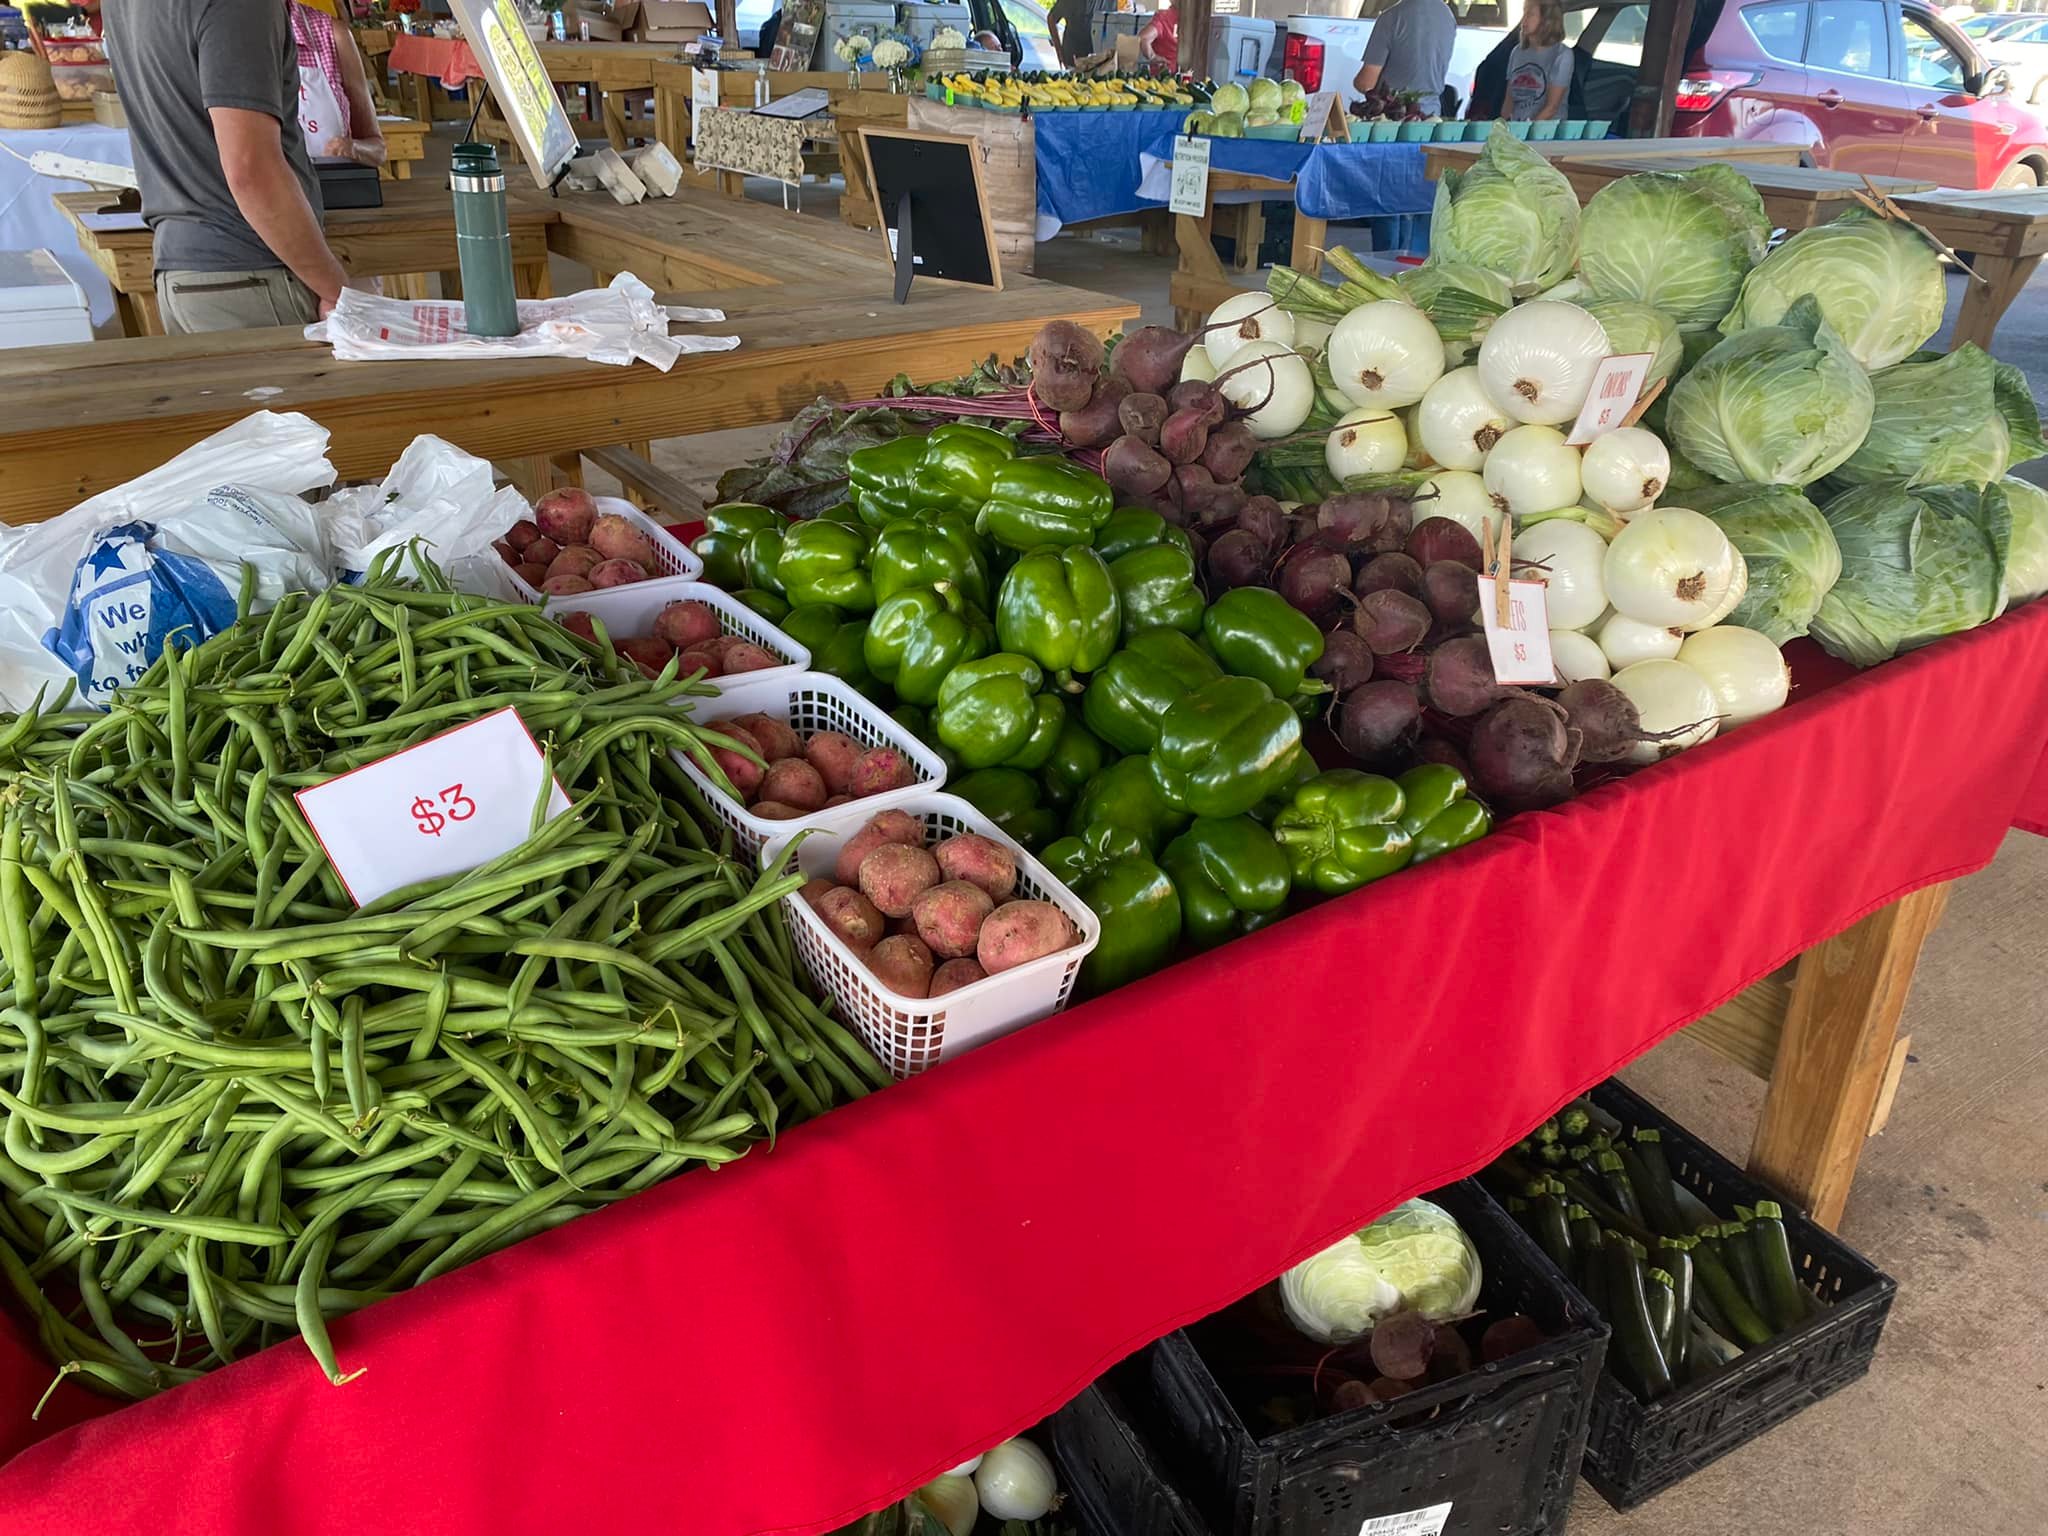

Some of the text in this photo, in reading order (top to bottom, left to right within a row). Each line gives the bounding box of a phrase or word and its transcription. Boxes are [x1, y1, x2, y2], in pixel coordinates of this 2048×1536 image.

[98, 601, 147, 629] We
[1510, 599, 1528, 632] ETS
[89, 676, 120, 693] to
[410, 783, 477, 838] $3
